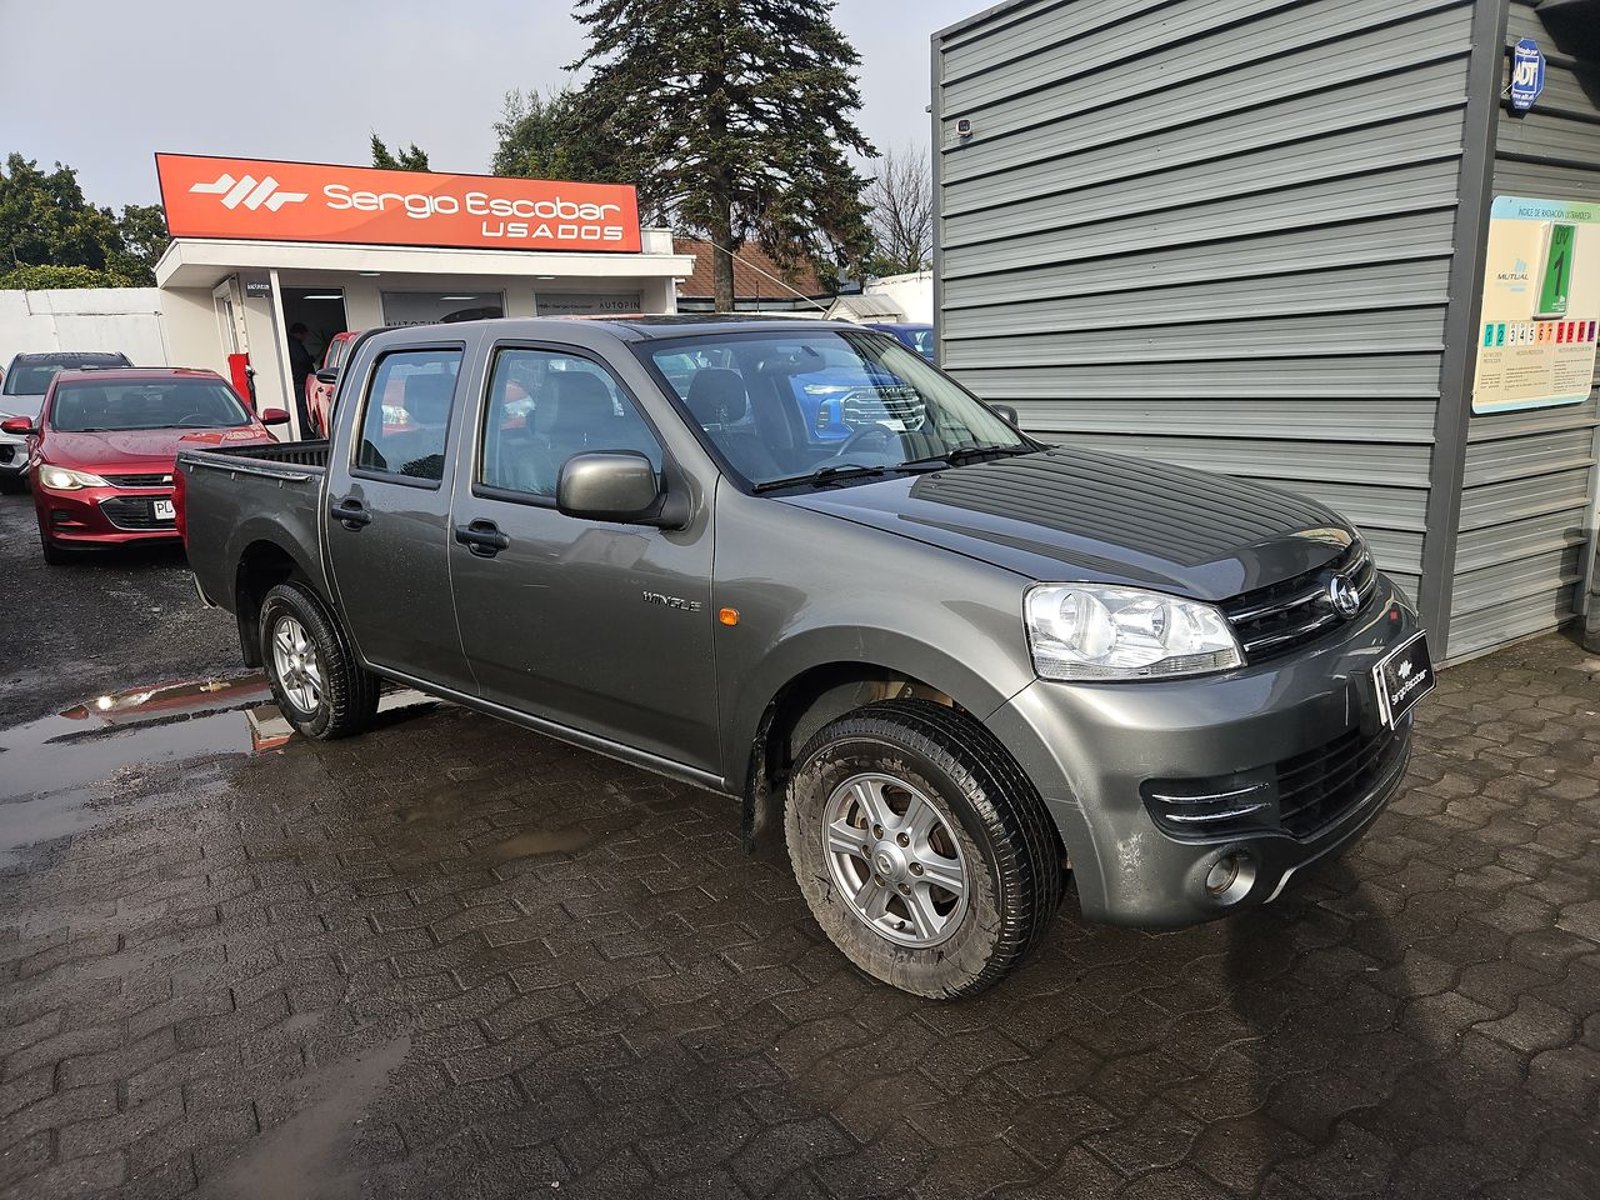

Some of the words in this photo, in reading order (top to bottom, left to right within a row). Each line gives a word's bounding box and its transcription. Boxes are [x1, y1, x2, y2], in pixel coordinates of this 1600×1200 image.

[1515, 60, 1538, 86] ADT
[323, 184, 459, 219] Sergio
[465, 192, 621, 221] Escobar
[481, 221, 624, 241] USADOS
[1556, 230, 1570, 245] UV
[1497, 273, 1529, 281] MUTUAL
[1554, 251, 1565, 297] 1
[600, 301, 640, 310] AUTOFIN
[1510, 329, 1516, 342] 3
[1519, 329, 1525, 340] 4
[1529, 329, 1534, 341] 5
[1538, 329, 1544, 341] 6
[643, 590, 702, 612] WINGLE
